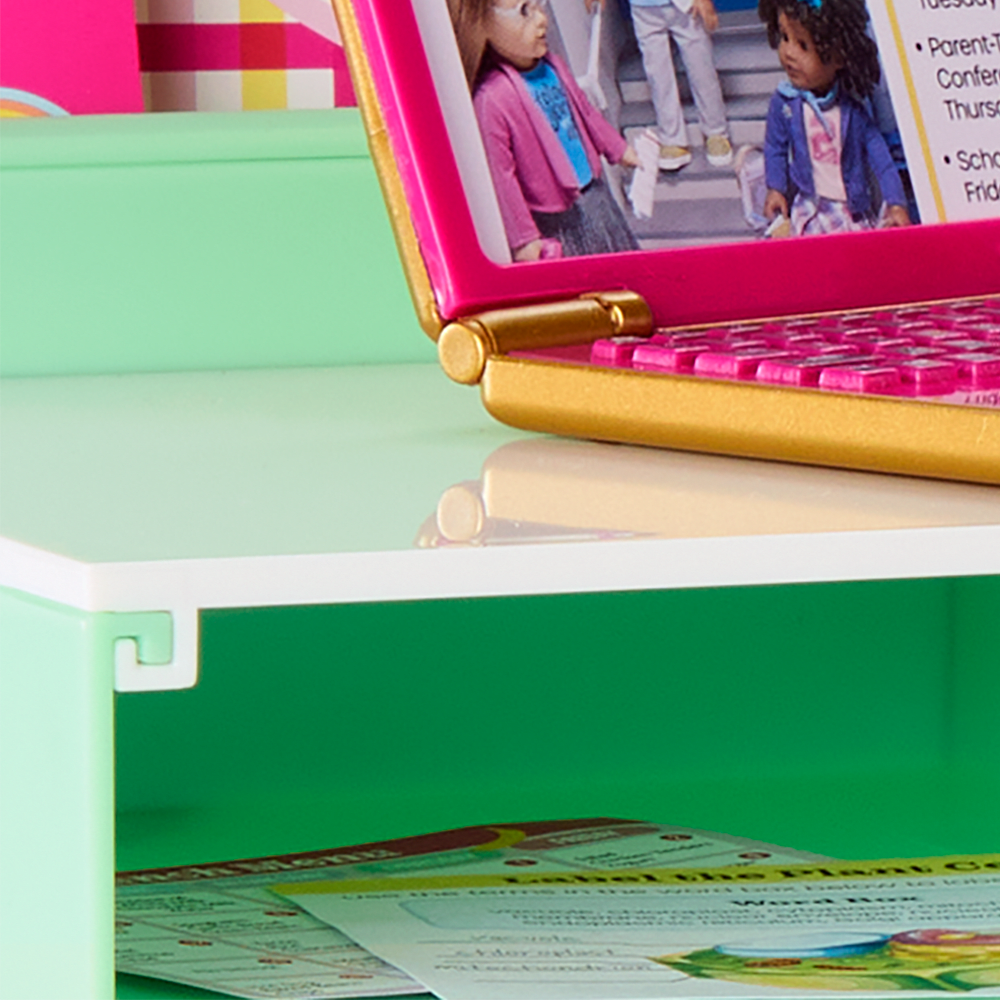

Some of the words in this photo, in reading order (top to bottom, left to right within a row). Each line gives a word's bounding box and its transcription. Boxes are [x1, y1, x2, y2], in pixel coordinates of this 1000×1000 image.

[502, 873, 659, 884] Label
[671, 871, 767, 882] the
[777, 864, 932, 878] Plant
[729, 898, 834, 906] Word
